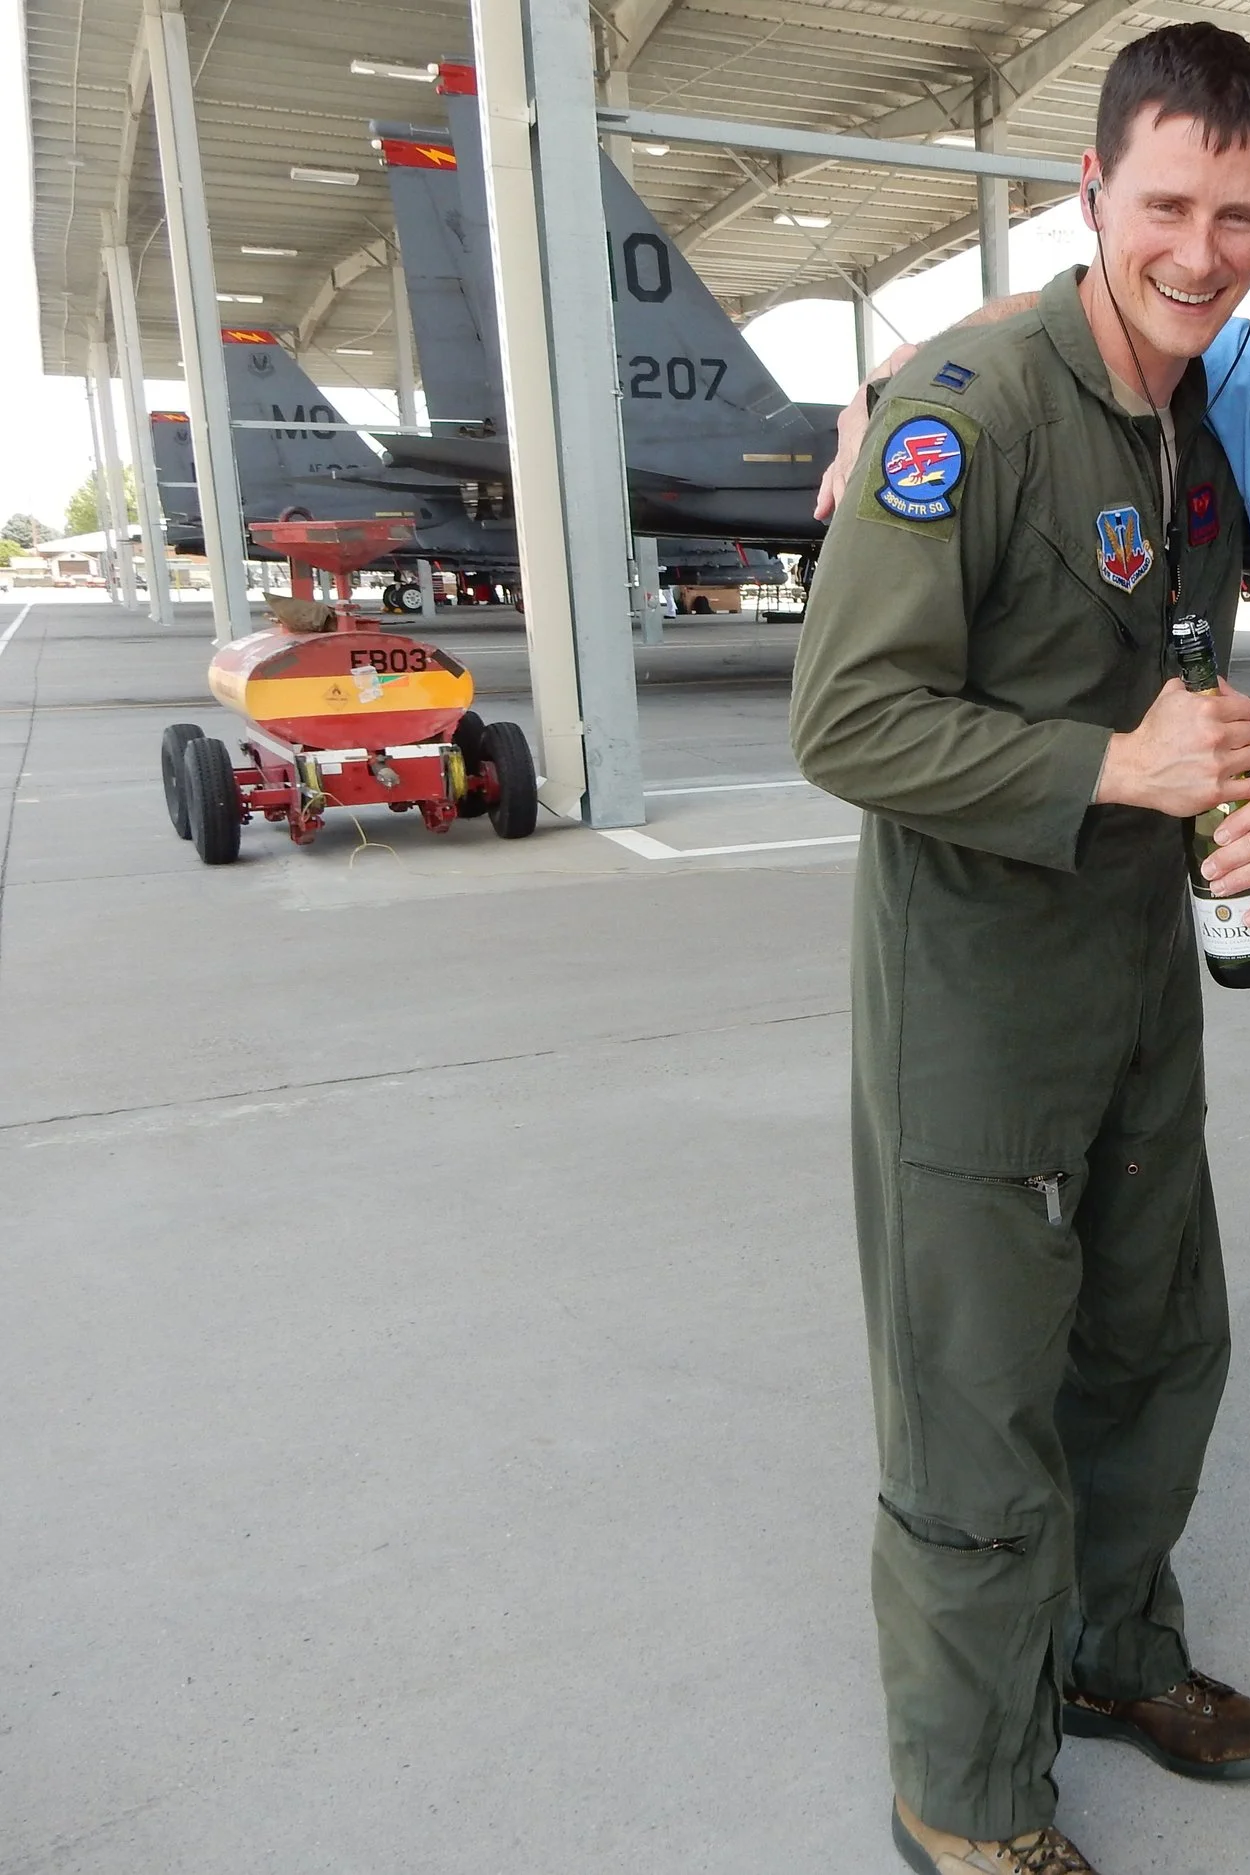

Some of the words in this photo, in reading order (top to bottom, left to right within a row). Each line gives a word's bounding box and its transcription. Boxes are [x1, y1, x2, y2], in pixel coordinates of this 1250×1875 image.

[606, 231, 672, 303] O
[617, 355, 728, 401] 207
[272, 404, 336, 440] MO
[884, 491, 907, 512] 389th
[907, 503, 927, 516] FTR
[929, 502, 944, 514] SQ
